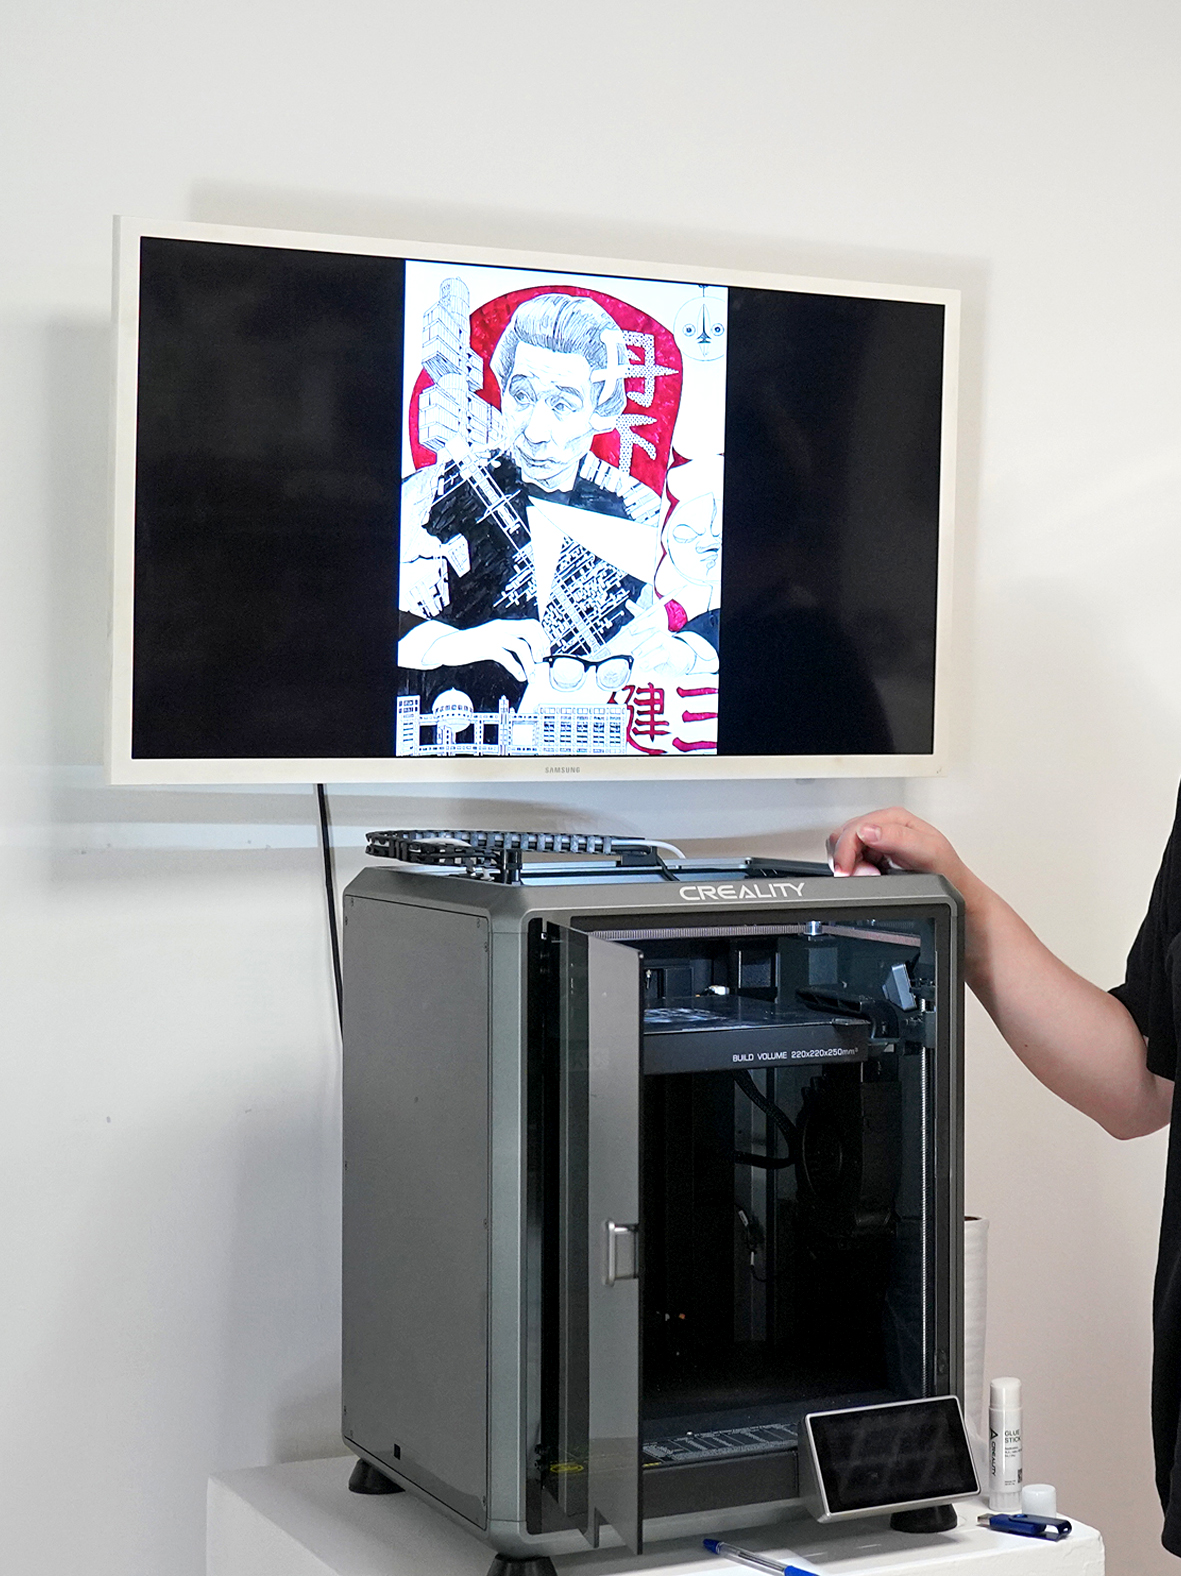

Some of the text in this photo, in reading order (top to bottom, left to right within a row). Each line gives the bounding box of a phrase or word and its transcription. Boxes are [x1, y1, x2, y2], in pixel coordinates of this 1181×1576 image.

[545, 766, 581, 774] SAMSUNG
[679, 882, 805, 900] CREALITY
[732, 1053, 754, 1062] BUILD
[757, 1051, 787, 1061] VOLUME
[1004, 1436, 1022, 1444] STICK
